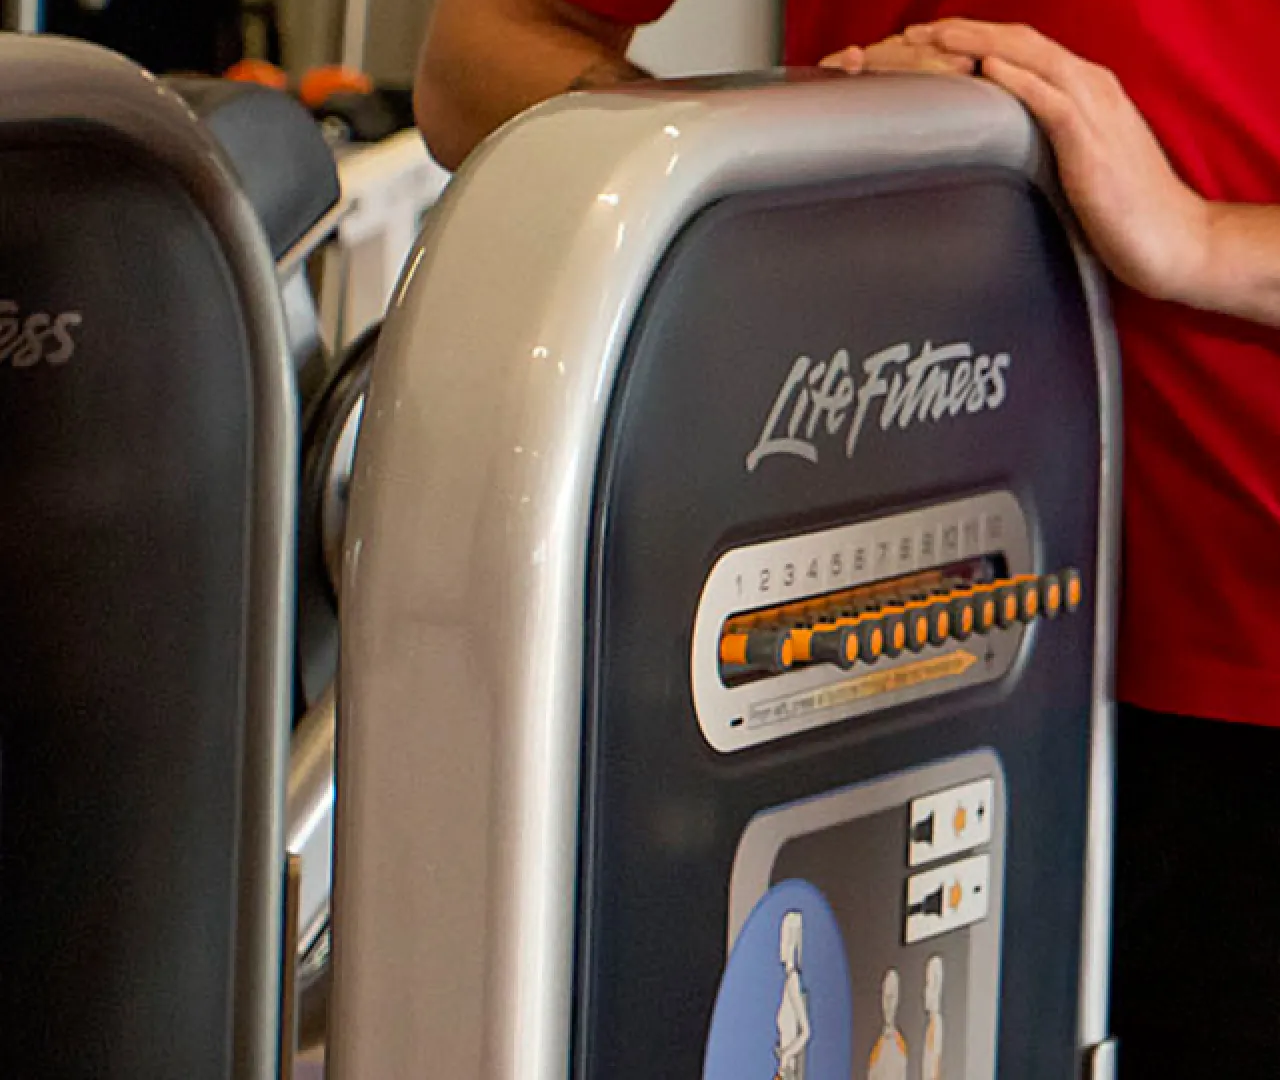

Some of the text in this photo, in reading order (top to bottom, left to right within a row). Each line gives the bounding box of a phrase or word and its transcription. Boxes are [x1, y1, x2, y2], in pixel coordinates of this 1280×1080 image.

[847, 340, 1010, 458] Fitness
[758, 568, 770, 592] 2
[783, 562, 795, 587] 3
[830, 552, 843, 577] 5
